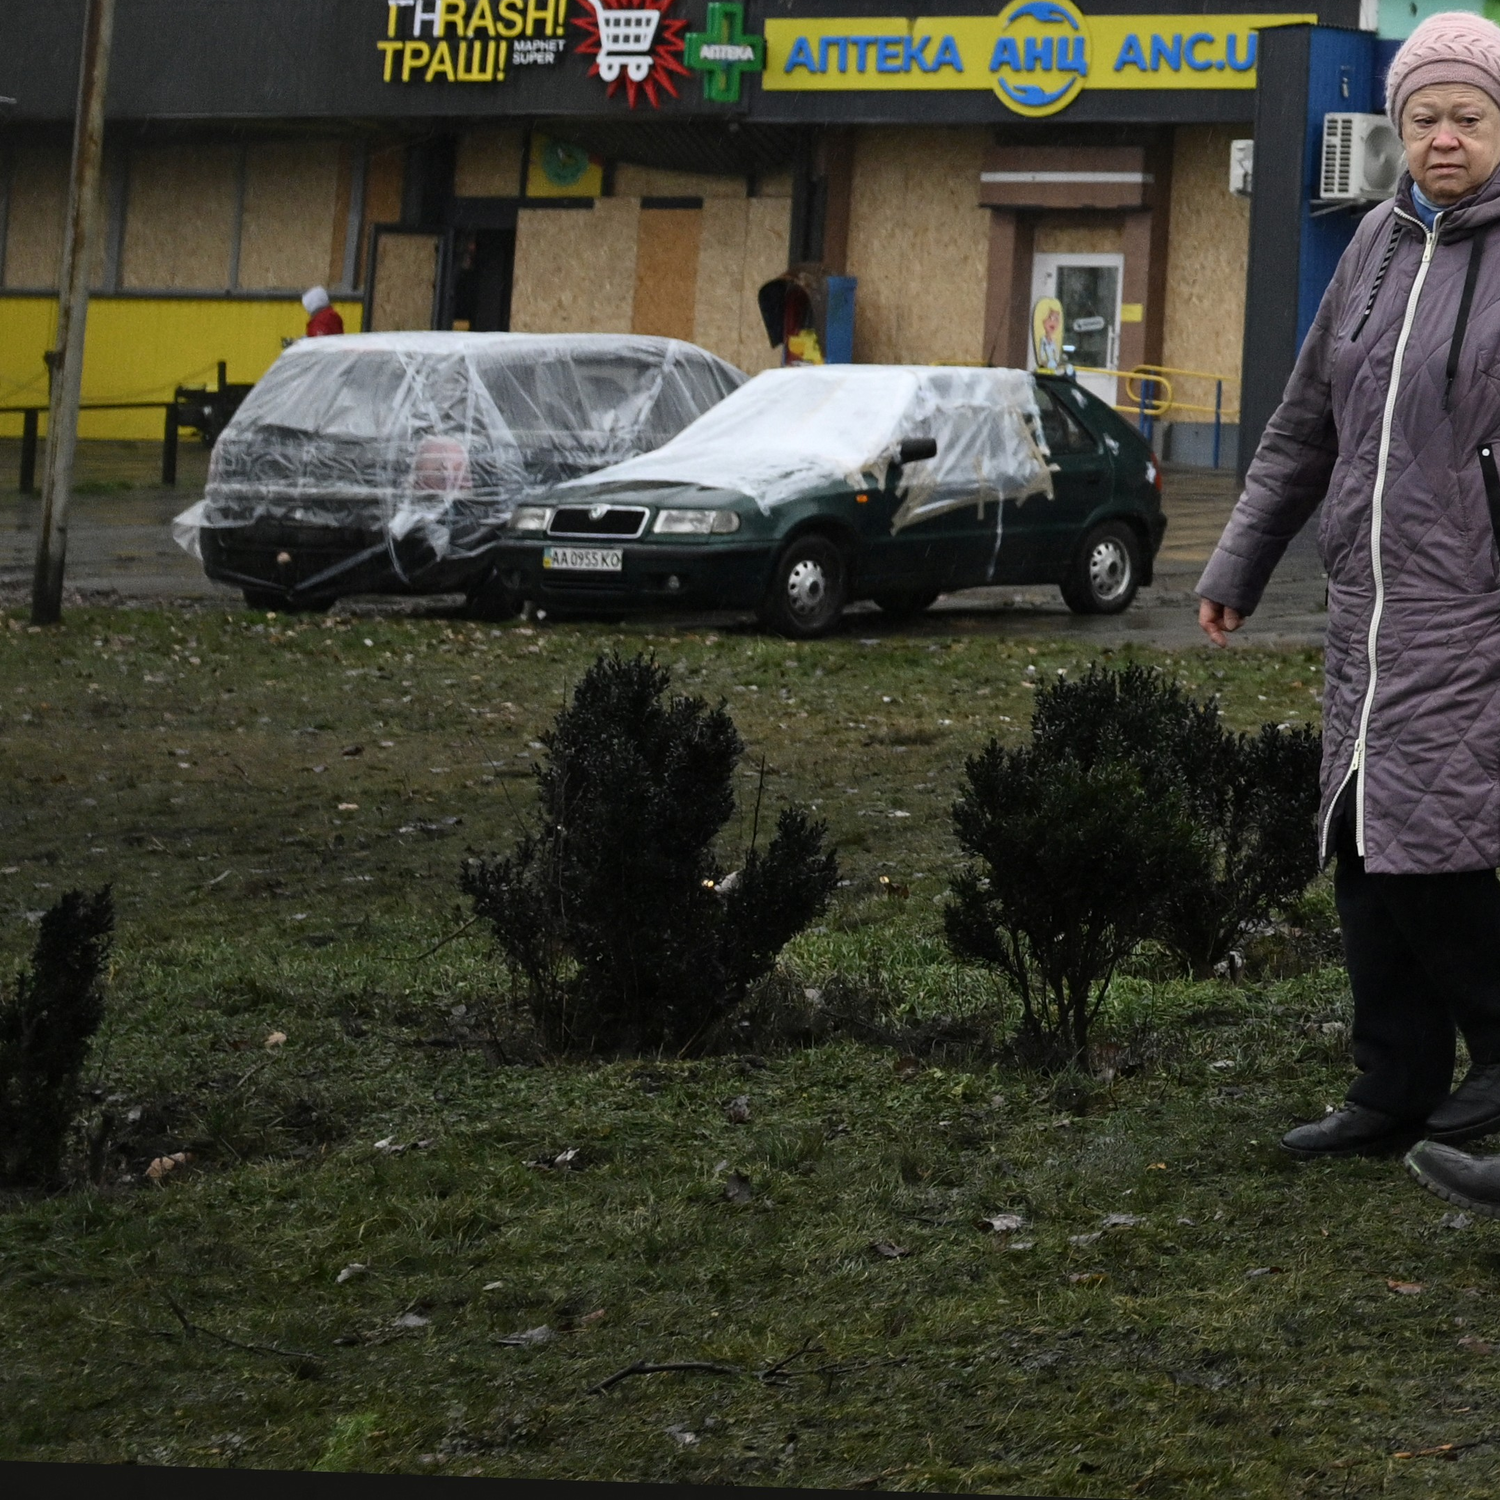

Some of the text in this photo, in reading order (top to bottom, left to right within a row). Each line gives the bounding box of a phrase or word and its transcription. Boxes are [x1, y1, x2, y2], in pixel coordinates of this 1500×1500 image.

[376, 40, 508, 83] ТРАШ!
[512, 51, 555, 65] SUPER
[700, 44, 754, 62] АПТЕКА
[784, 35, 964, 74] АПТЕКА
[988, 36, 1088, 77] АНЦ
[552, 551, 568, 566] AA
